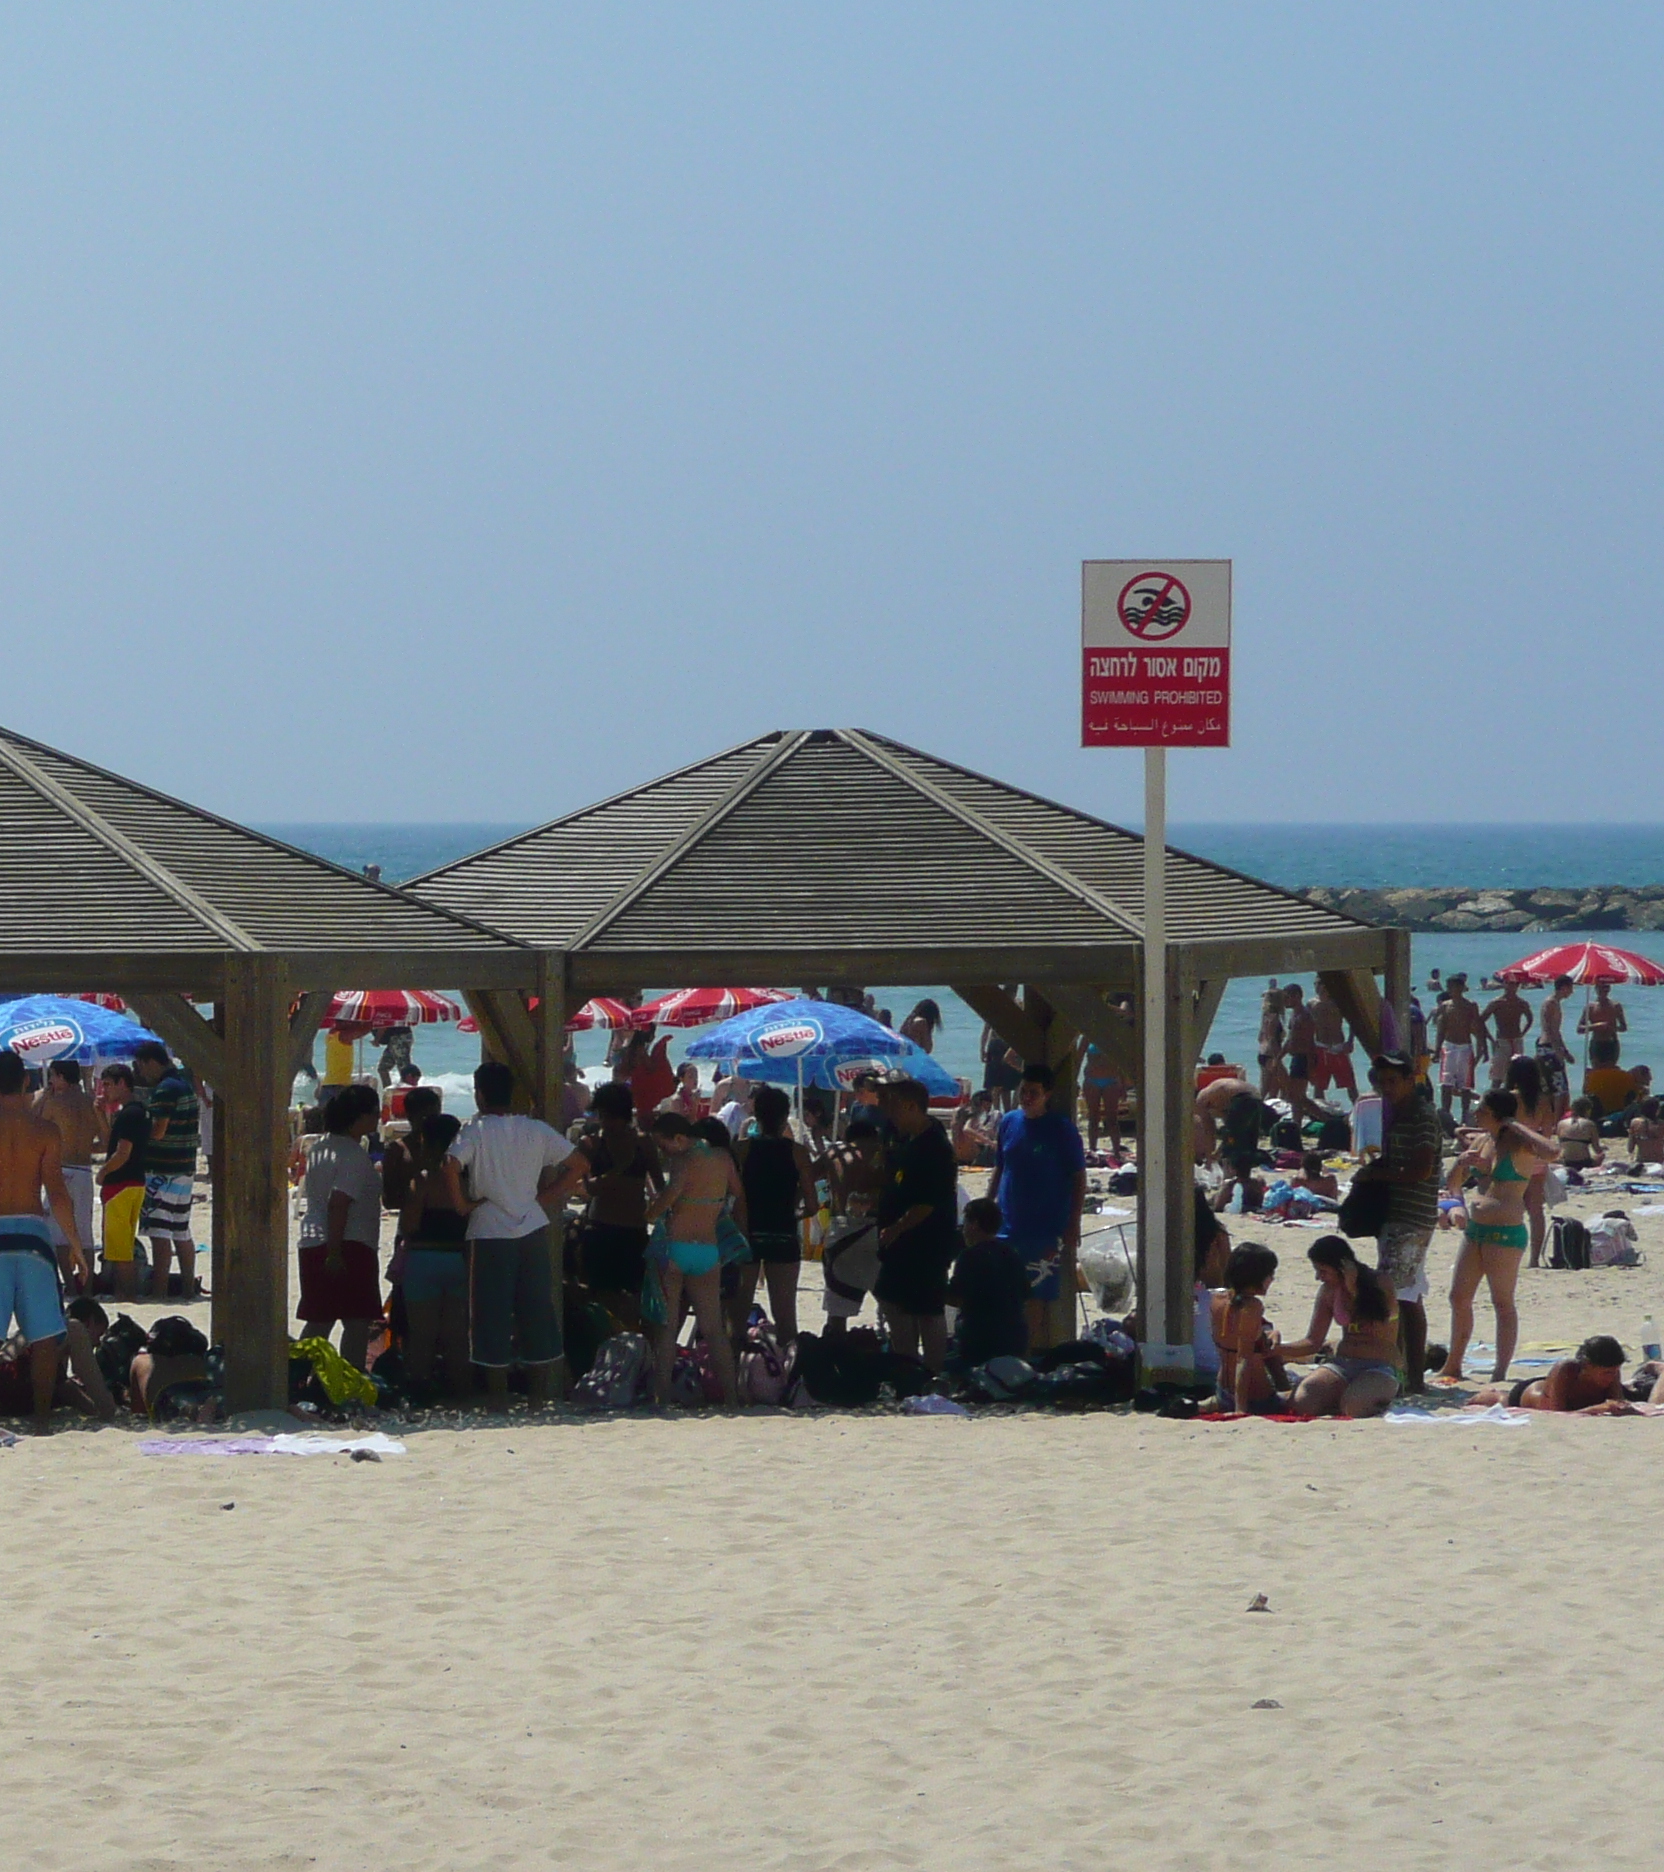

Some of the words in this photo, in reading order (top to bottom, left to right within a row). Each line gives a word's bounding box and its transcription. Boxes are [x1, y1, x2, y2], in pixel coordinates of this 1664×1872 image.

[1090, 651, 1137, 678] לרחצה
[1143, 657, 1177, 678] אסור
[1183, 657, 1221, 683] מקום
[1090, 690, 1149, 705] SWIMMING
[1154, 690, 1222, 705] PROHIBITED
